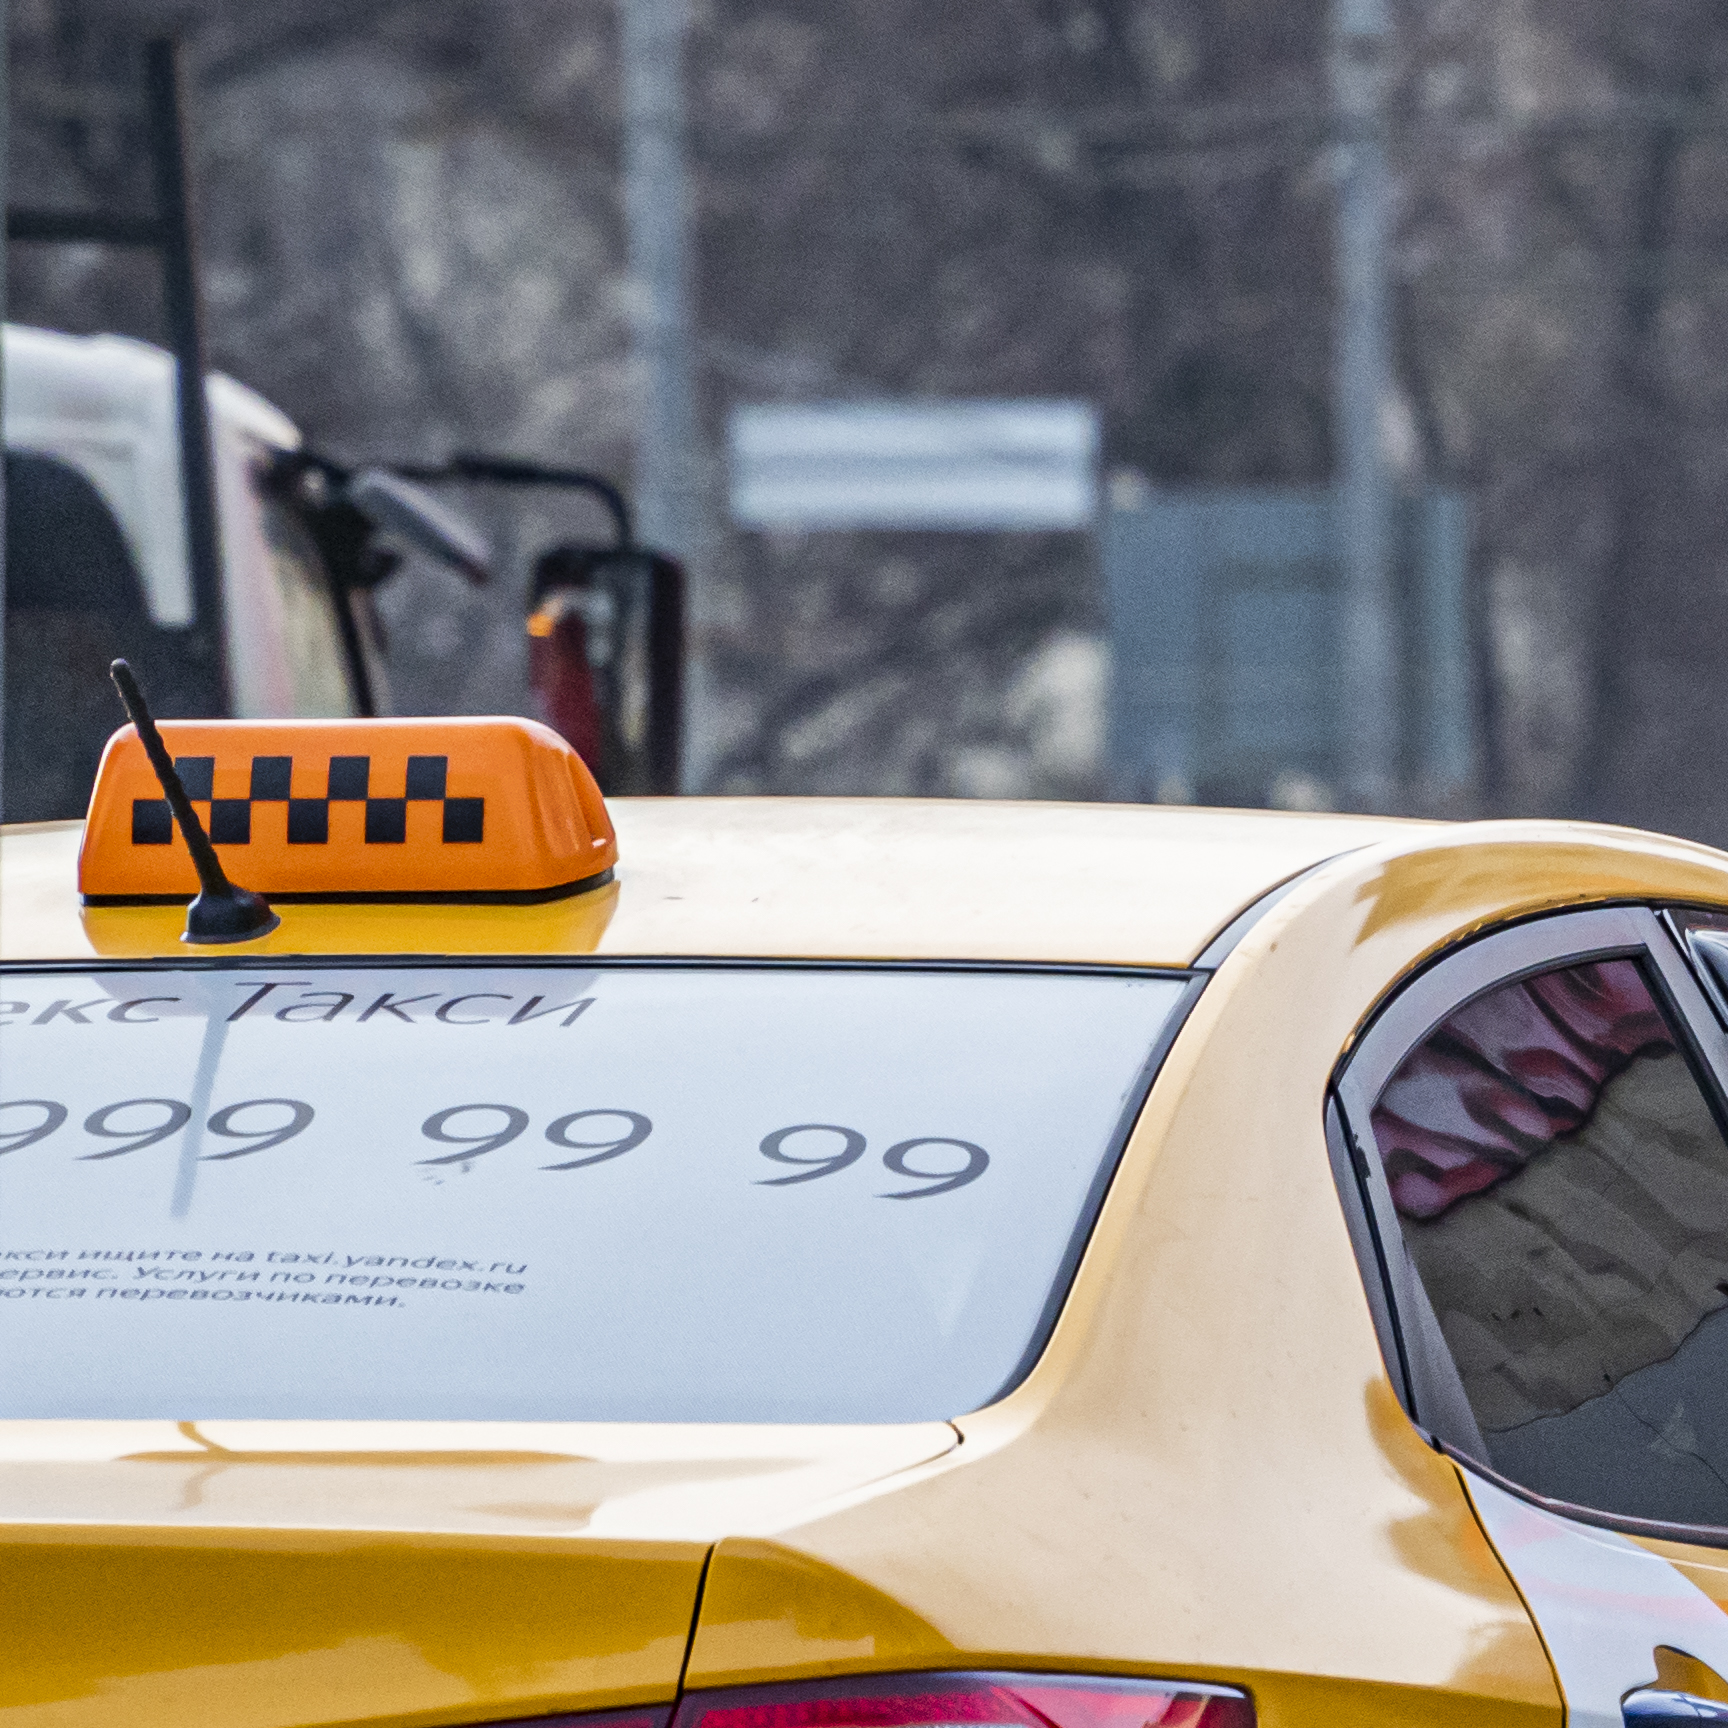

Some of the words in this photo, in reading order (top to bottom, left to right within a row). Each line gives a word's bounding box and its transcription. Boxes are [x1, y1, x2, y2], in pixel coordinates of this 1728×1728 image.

[227, 981, 598, 1027] Такси
[411, 1102, 653, 1171] 99
[749, 1123, 990, 1200] 99
[132, 1266, 261, 1284] Услуги
[270, 1271, 316, 1284] по
[324, 1273, 526, 1295] перевозке
[266, 1251, 528, 1275] taxi.yandex.ru
